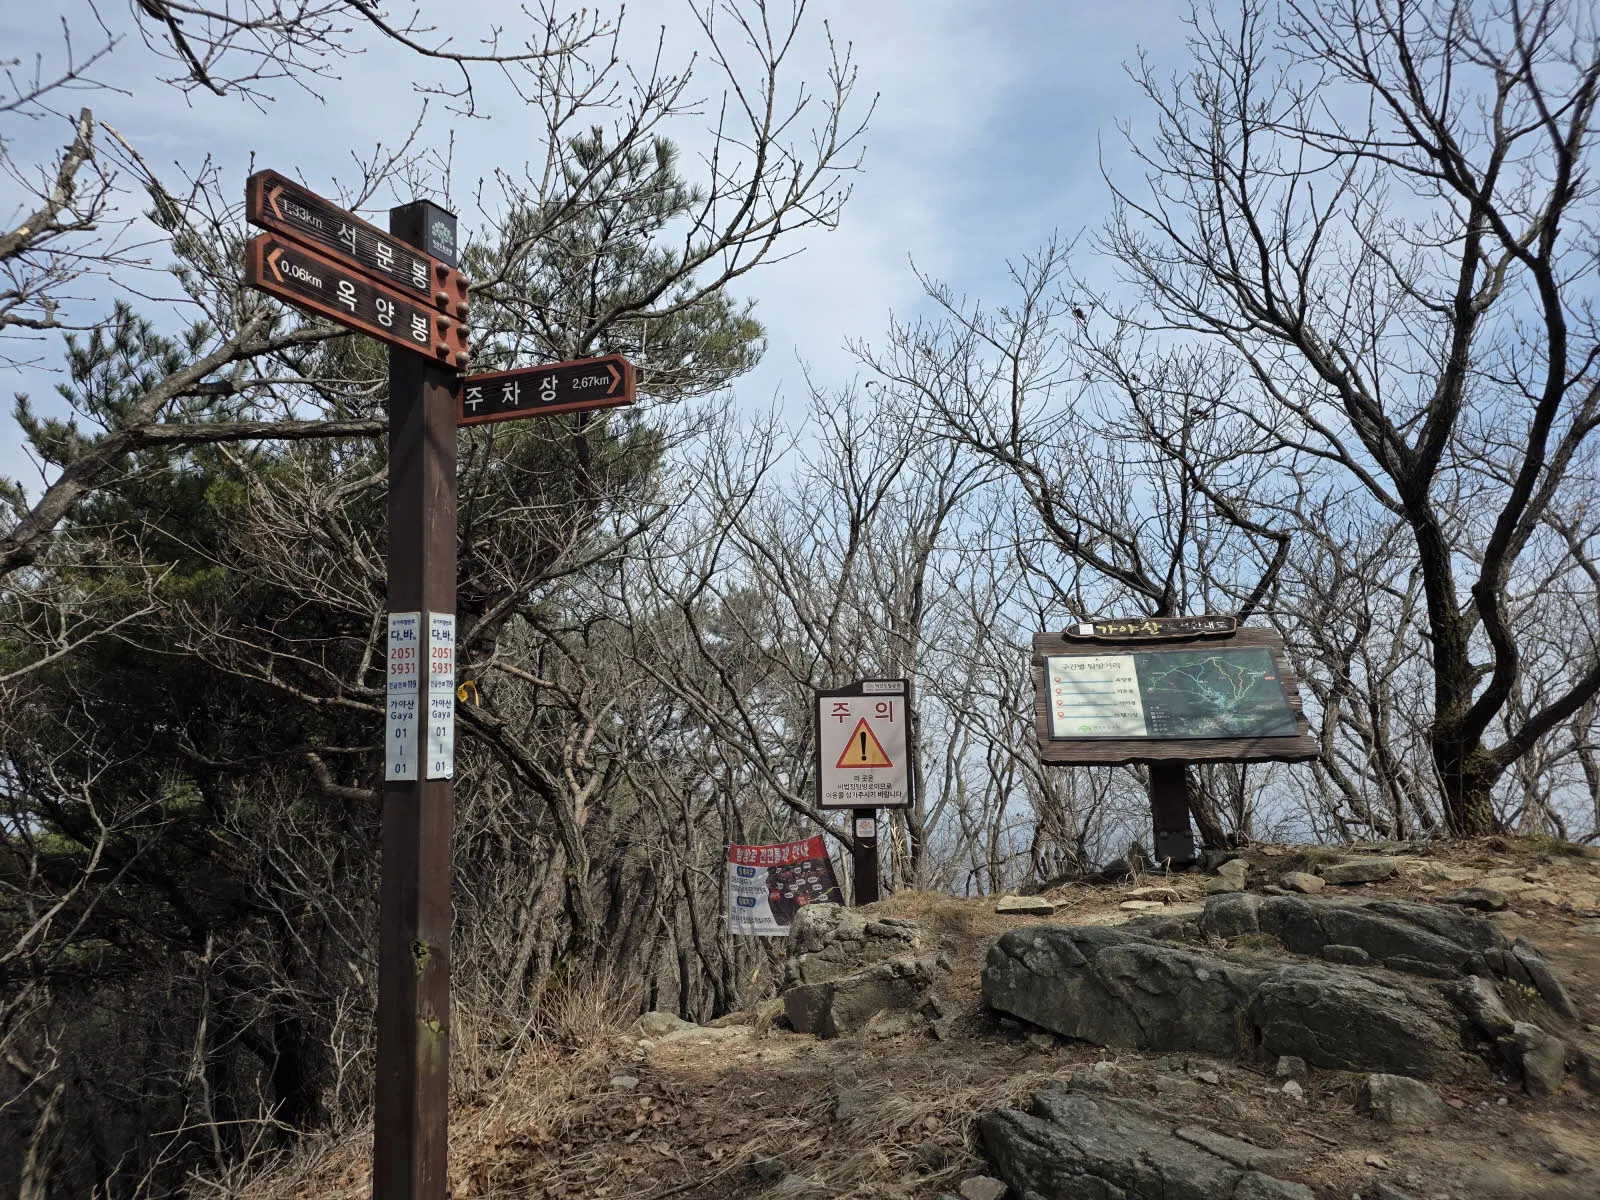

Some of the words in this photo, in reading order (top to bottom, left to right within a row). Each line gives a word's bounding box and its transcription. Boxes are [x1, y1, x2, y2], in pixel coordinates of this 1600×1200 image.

[282, 199, 323, 230] 1.33km
[280, 259, 323, 289] 0.06km
[336, 279, 429, 343] 옥양봉
[464, 374, 559, 412] 주차장
[572, 375, 610, 390] 2.67km
[1096, 621, 1163, 635] 가야산
[391, 647, 416, 660] 2051
[431, 646, 453, 659] 2051
[391, 662, 416, 675] 5931
[431, 662, 453, 674] 5931
[407, 680, 417, 689] 119
[446, 680, 454, 689] 119
[390, 699, 415, 710] 가야산
[431, 699, 452, 709] 가야산
[390, 711, 414, 722] Gaya
[431, 709, 451, 720] Gaya
[830, 700, 894, 723] 주의
[395, 728, 407, 738] 01
[436, 726, 446, 737] 01
[394, 763, 407, 774] 01
[435, 761, 446, 772] 01
[861, 774, 875, 783] 곳은
